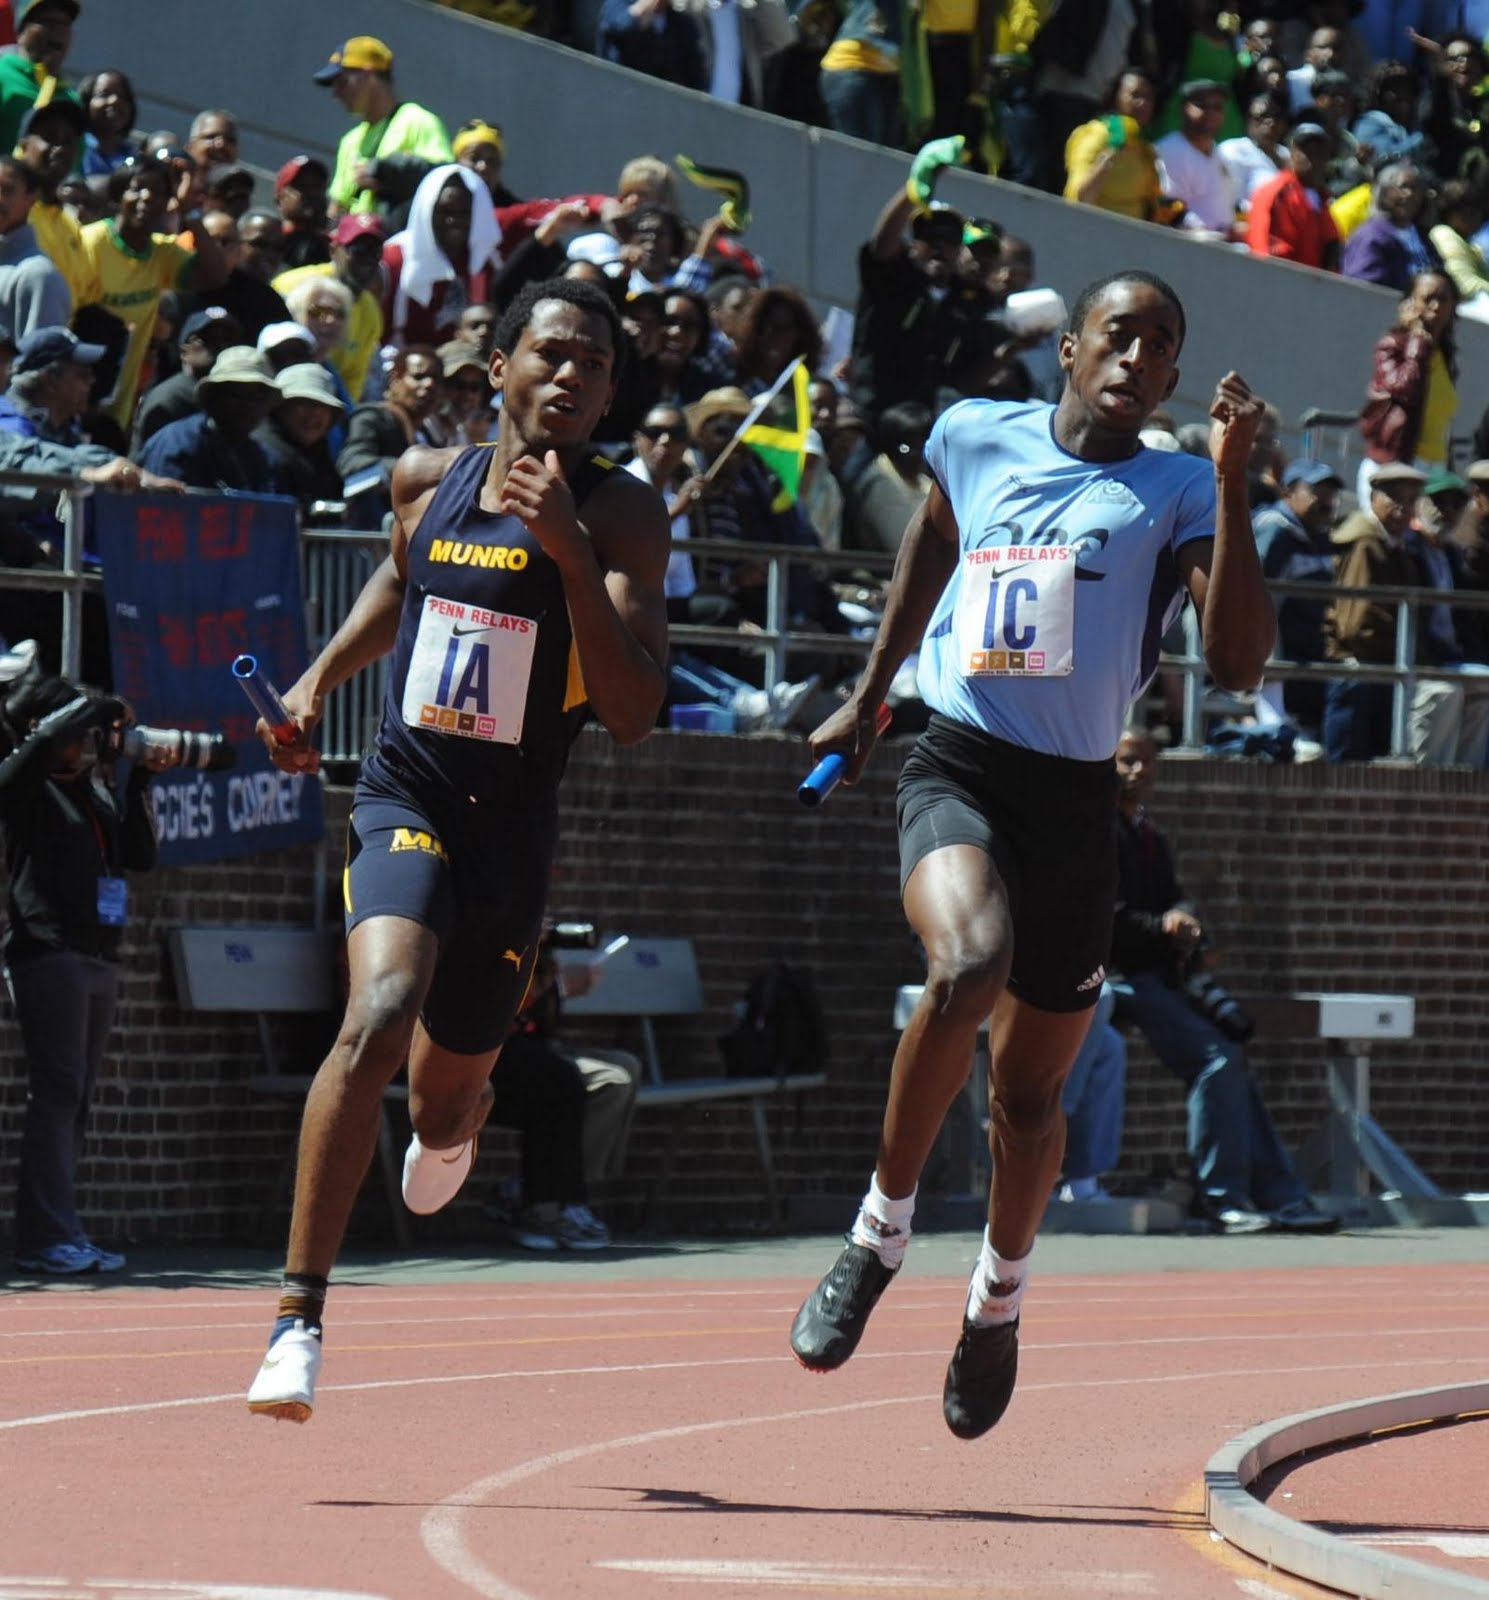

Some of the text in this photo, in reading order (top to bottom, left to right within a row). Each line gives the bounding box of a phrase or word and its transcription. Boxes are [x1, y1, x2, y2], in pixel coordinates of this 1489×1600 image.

[428, 538, 529, 572] MUNRO
[969, 546, 1069, 565] PENN RELAYS
[430, 598, 530, 634] PENN RELAYS
